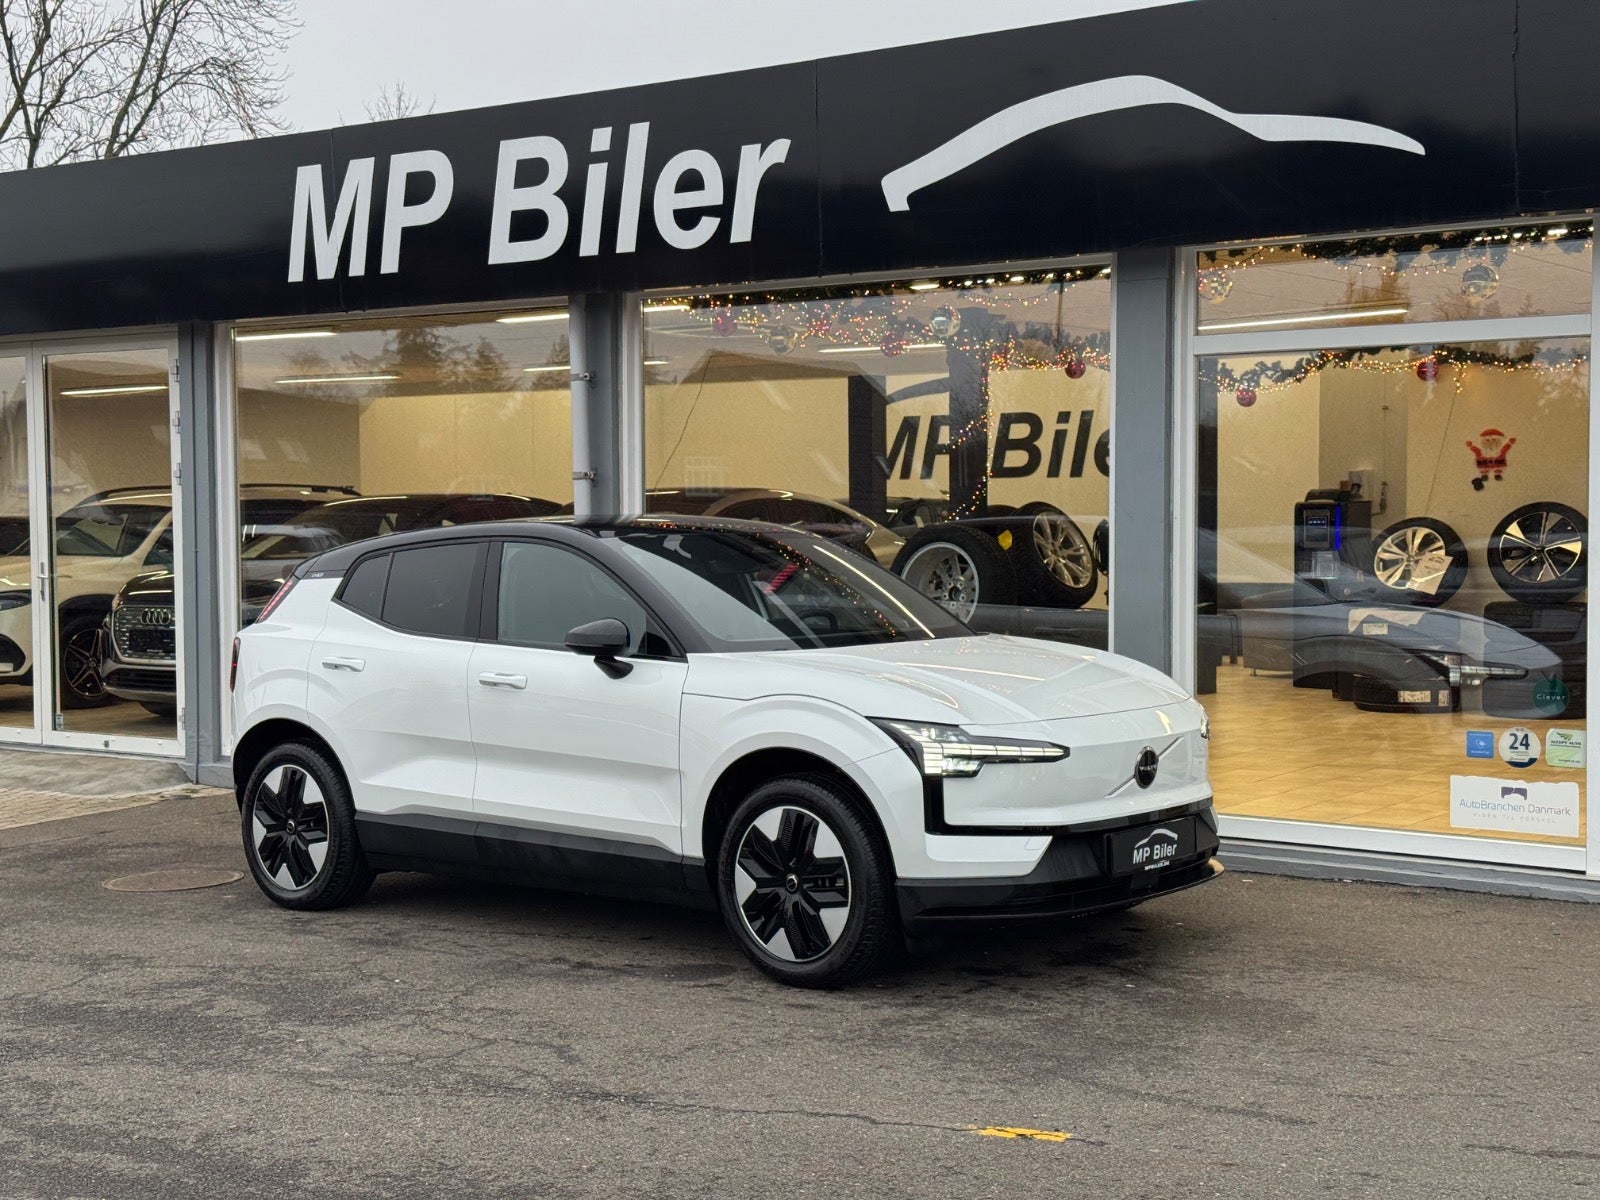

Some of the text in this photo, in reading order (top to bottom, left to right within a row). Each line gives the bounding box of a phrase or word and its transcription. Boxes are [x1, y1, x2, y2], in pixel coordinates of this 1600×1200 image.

[288, 122, 792, 283] MP Biler
[1536, 693, 1567, 701] Clever
[1509, 733, 1530, 751] 24
[1459, 799, 1571, 816] AutoBranchen Danmark
[1133, 843, 1177, 864] MP Biler
